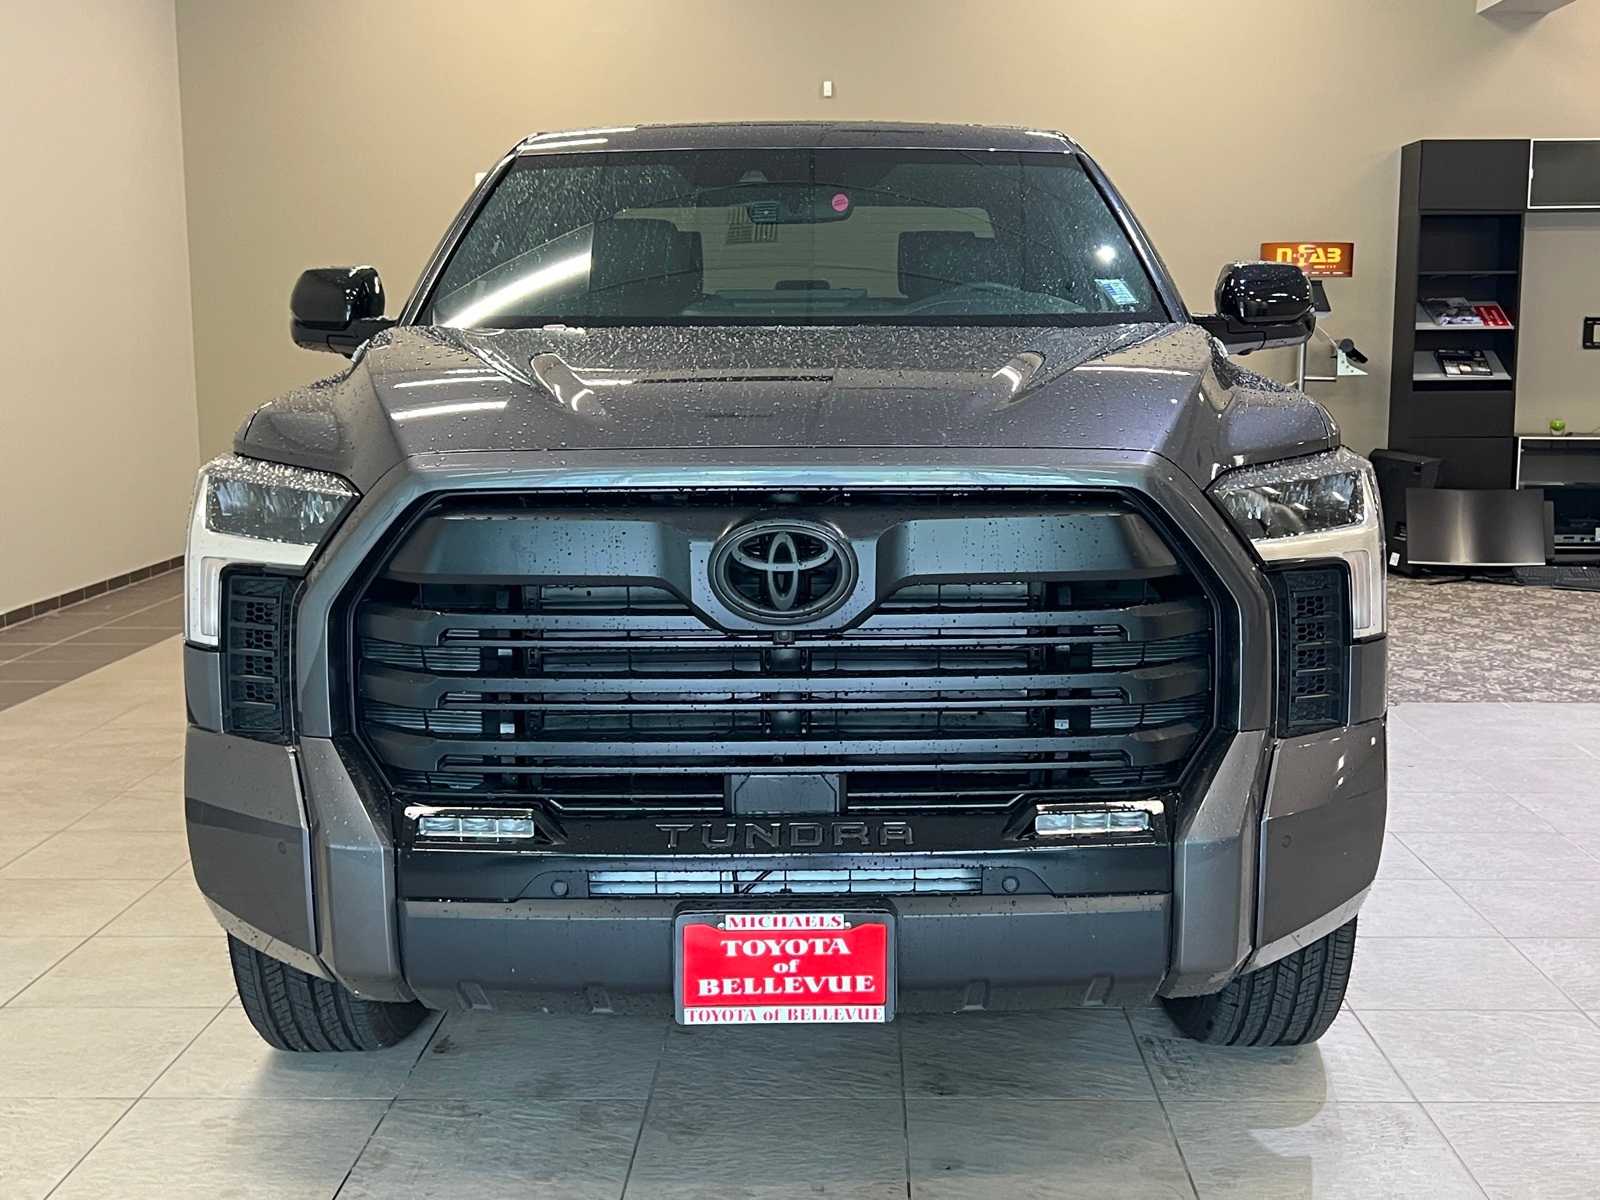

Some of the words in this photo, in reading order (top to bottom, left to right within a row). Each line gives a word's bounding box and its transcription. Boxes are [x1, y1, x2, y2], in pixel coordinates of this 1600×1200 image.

[655, 822, 914, 849] TUNDRA
[728, 915, 843, 928] MICHAELS
[720, 937, 852, 957] TOYOTA
[772, 959, 800, 974] of
[697, 975, 876, 997] BELLEVUE
[686, 1008, 757, 1023] TOYOTA
[763, 1007, 780, 1021] of
[787, 1005, 883, 1021] BELLEVUE
